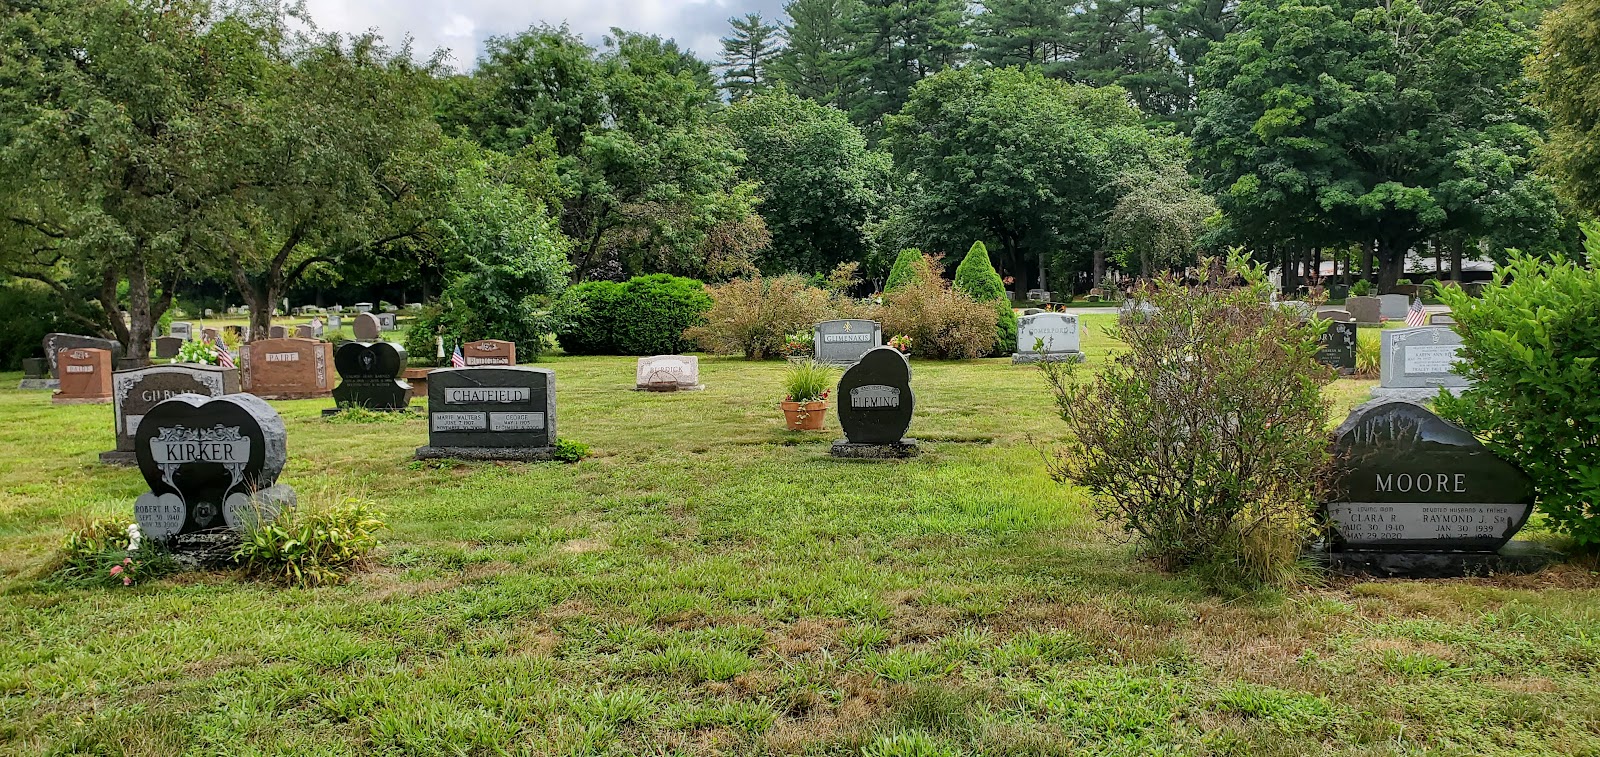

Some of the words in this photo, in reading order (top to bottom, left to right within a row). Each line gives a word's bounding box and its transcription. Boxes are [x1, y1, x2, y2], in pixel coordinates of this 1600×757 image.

[453, 390, 522, 402] CHATFIELD
[853, 396, 898, 408] FLEMING
[166, 443, 236, 461] KIRKER
[1375, 473, 1467, 492] MOORE
[1350, 514, 1384, 522] CLARA
[1423, 514, 1473, 523] RAYMOND
